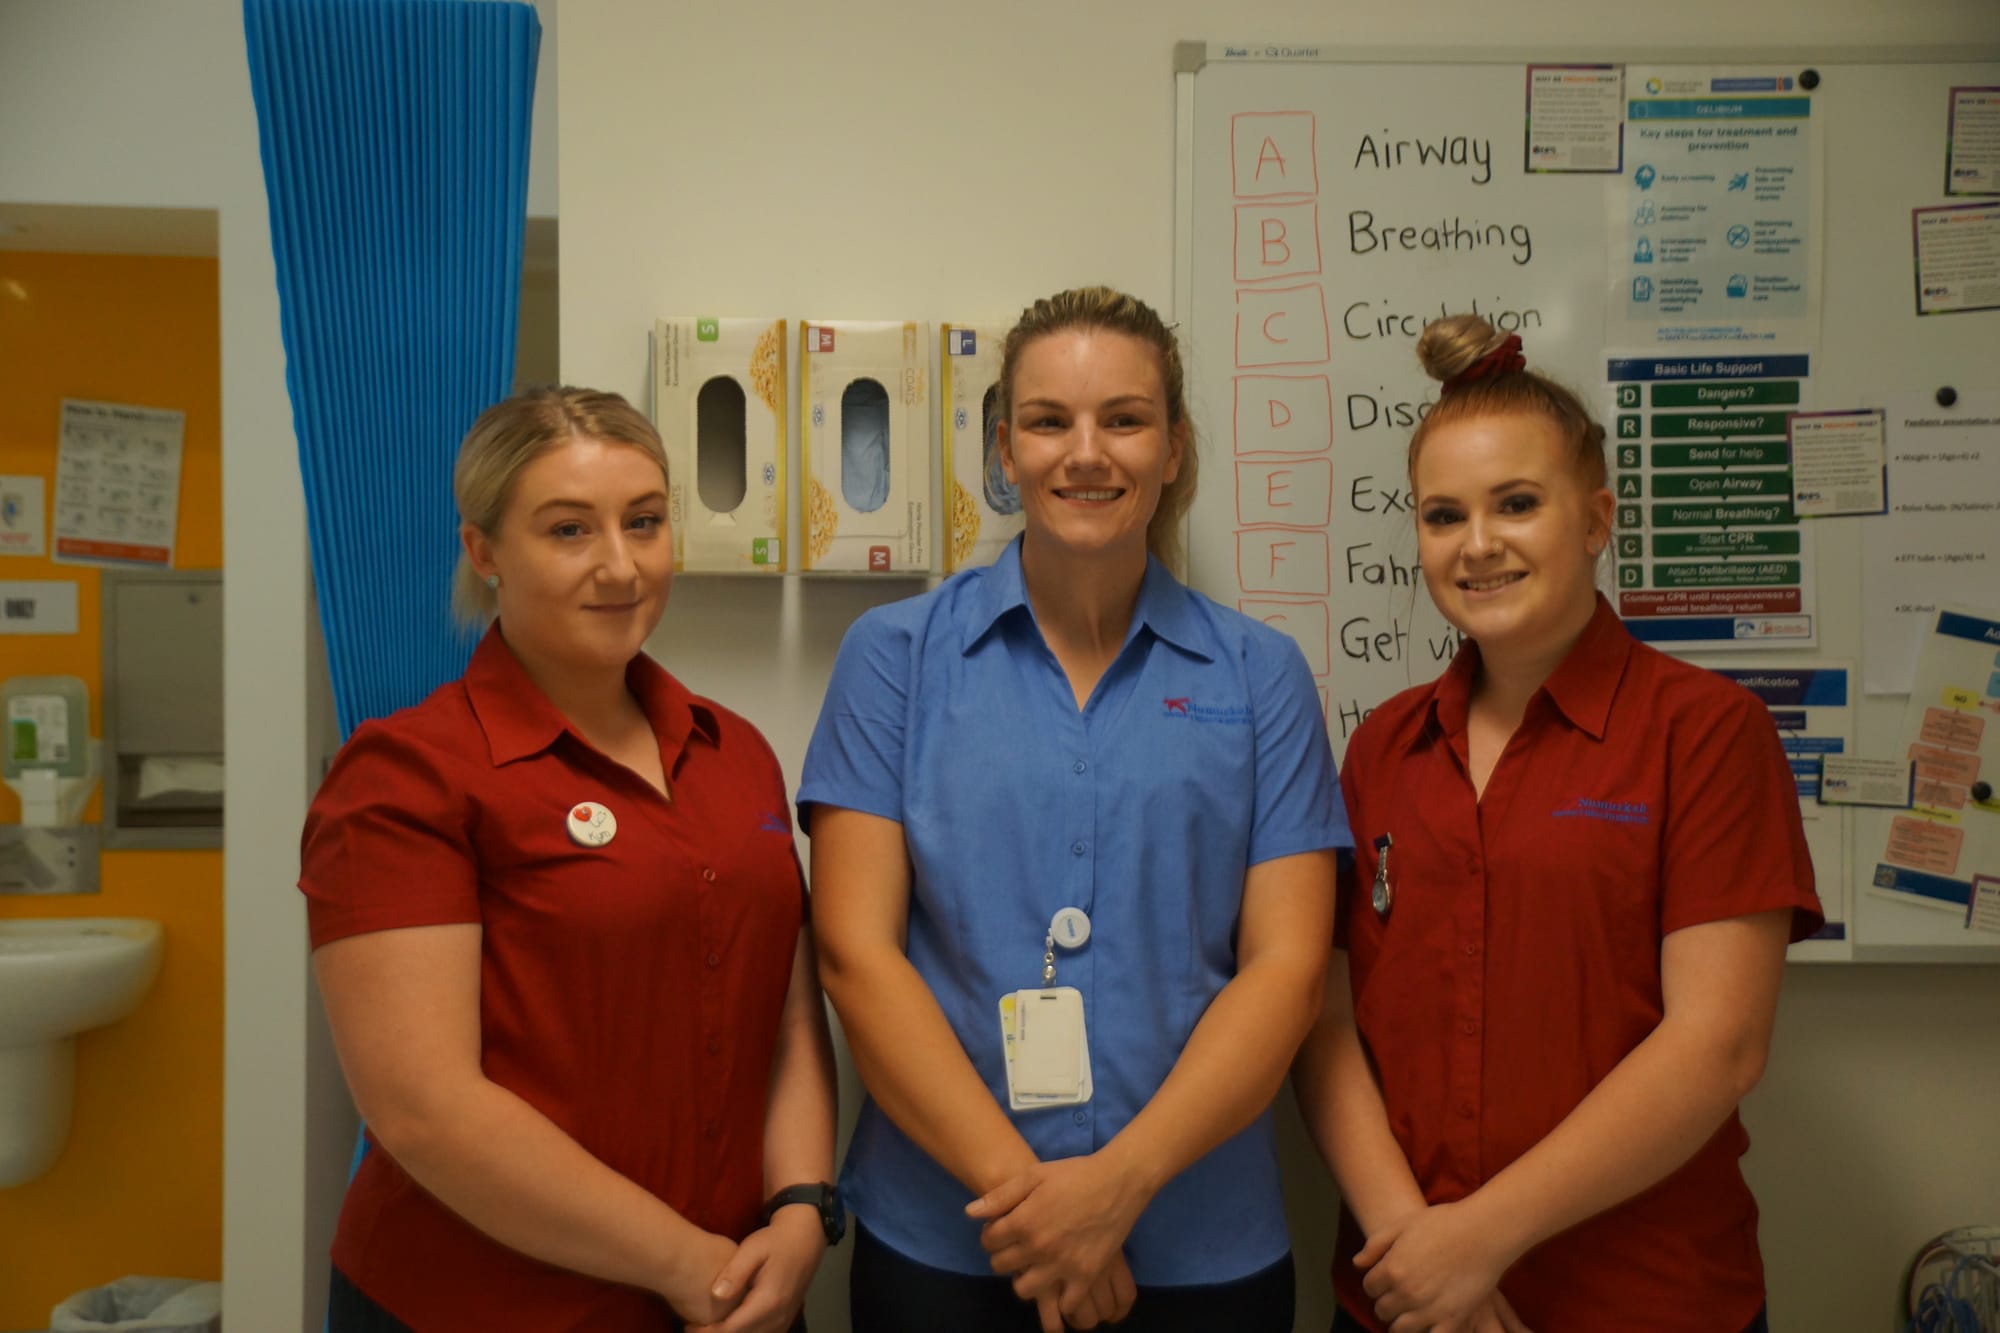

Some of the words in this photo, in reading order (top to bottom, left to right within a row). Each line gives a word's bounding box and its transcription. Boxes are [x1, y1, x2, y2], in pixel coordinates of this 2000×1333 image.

[1640, 127, 1661, 139] Key
[1664, 127, 1697, 139] steps
[1698, 126, 1714, 137] for
[1717, 125, 1774, 137] treatment
[1776, 125, 1798, 136] and
[1688, 140, 1750, 152] prevention
[1255, 136, 1286, 181] A
[1354, 128, 1492, 185] Airway
[1260, 218, 1291, 266] B
[1348, 210, 1532, 265] Breathing
[1344, 296, 1542, 339] Circion
[701, 324, 715, 334] S
[1262, 312, 1288, 343] C
[820, 333, 832, 346] M
[962, 338, 973, 347] L
[1654, 363, 1688, 375] Basic
[1690, 362, 1713, 374] Life
[1715, 361, 1764, 375] Support
[1623, 388, 1636, 403] D
[1697, 386, 1755, 400] Dangers?
[1269, 400, 1293, 428] D
[1623, 419, 1636, 433] R
[1687, 417, 1764, 431] Responsive?
[1623, 449, 1635, 464] S
[1689, 448, 1719, 460] Send
[1721, 448, 1737, 459] for
[1738, 447, 1763, 460] help
[1267, 470, 1294, 507] E
[1623, 479, 1637, 493] A
[1689, 478, 1720, 491] Open
[1722, 477, 1763, 491] Airway
[1624, 509, 1636, 524] B
[1673, 508, 1713, 521] Normal
[1715, 506, 1780, 520] Breathing?
[1698, 533, 1726, 545] Start
[1728, 532, 1755, 543] CPR
[1624, 539, 1637, 554] C
[873, 552, 886, 565] M
[1270, 541, 1297, 578] F
[1624, 569, 1637, 583] D
[1667, 566, 1697, 577] Attach
[1699, 564, 1756, 576] Defibrillator
[1758, 563, 1788, 576] (AED)
[1623, 593, 1665, 602] Continue
[1667, 592, 1687, 601] CPR
[1690, 591, 1710, 601] until
[1712, 590, 1783, 601] responsiveness
[1786, 590, 1796, 599] or
[1656, 604, 1688, 613] normal
[1690, 602, 1733, 613] breathing
[1735, 602, 1764, 611] return
[1340, 617, 1407, 663] Get
[1736, 676, 1799, 688] notification
